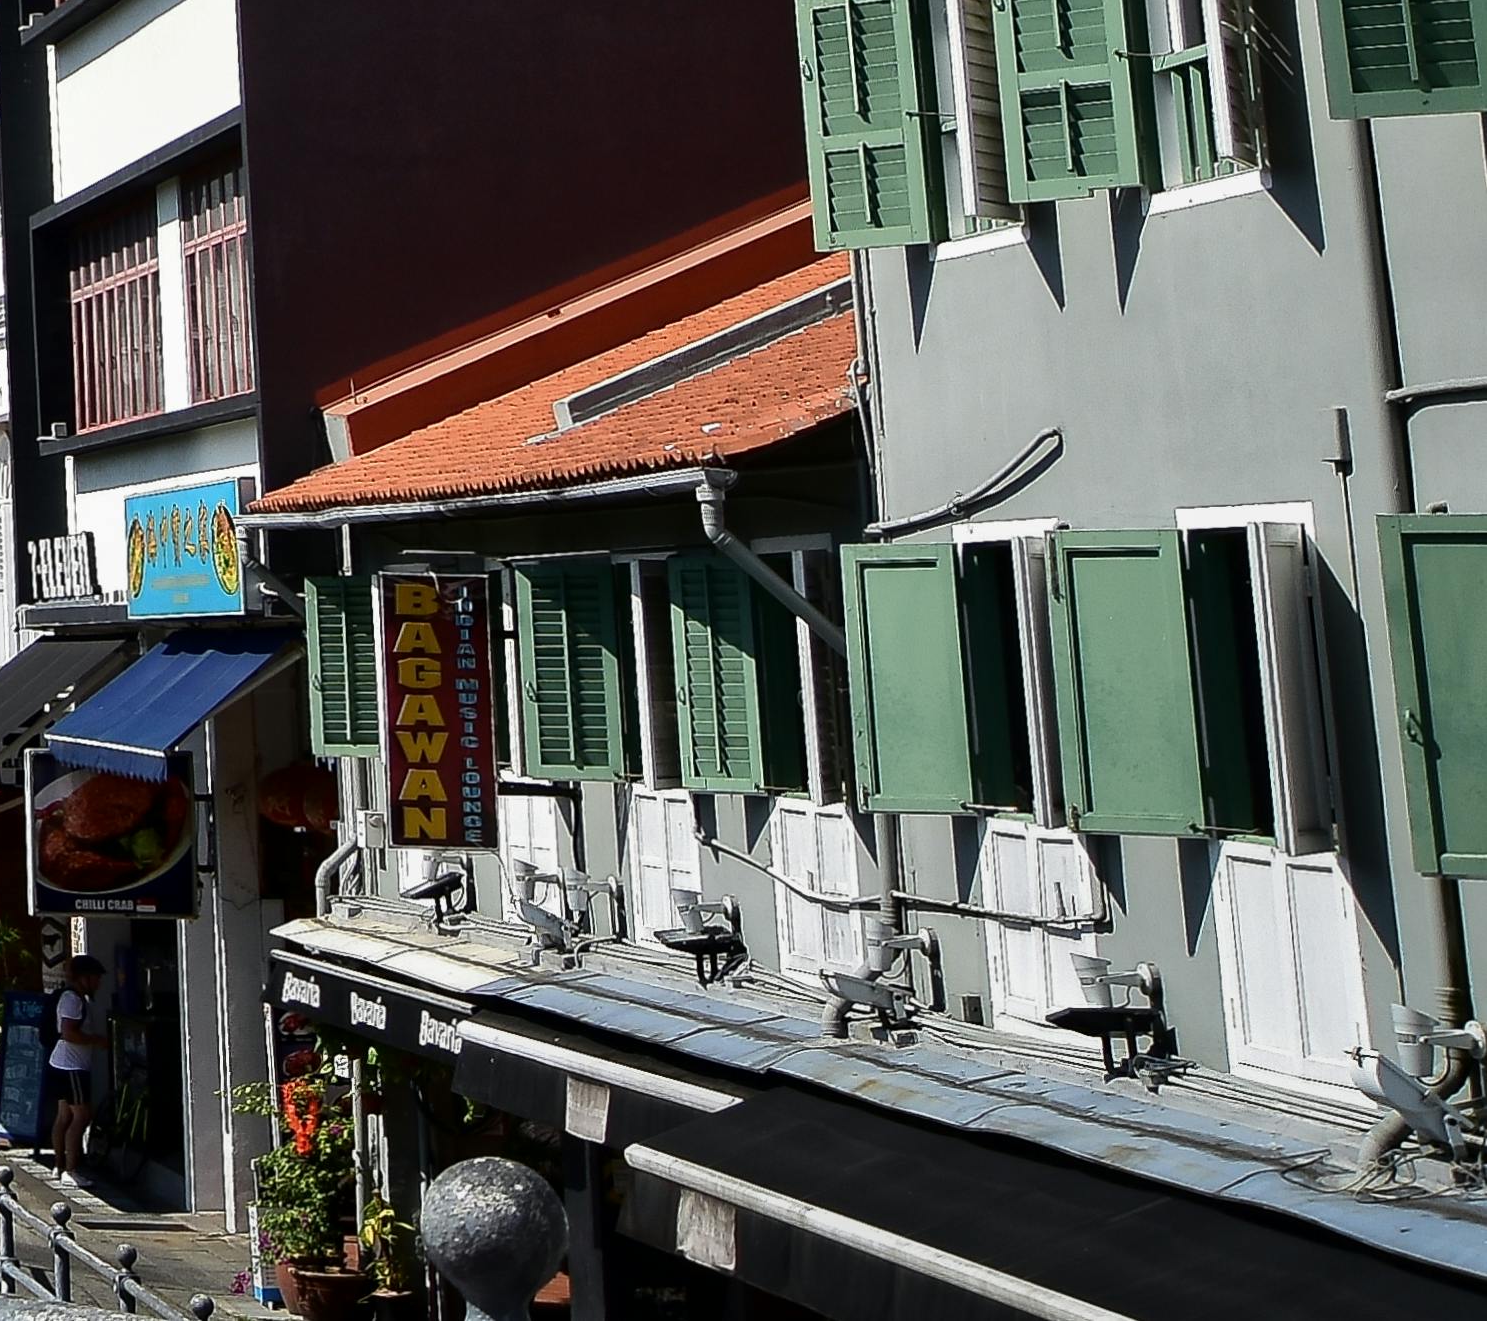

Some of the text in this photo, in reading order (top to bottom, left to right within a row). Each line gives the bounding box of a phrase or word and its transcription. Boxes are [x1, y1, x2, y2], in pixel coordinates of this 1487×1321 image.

[393, 582, 449, 840] BAGAWAN
[455, 585, 483, 844] INDIAN MUSIC LOUNGE
[75, 899, 135, 911] CHILLI CRAB
[281, 971, 321, 1008] Bavaria
[349, 991, 388, 1030] Bavaria
